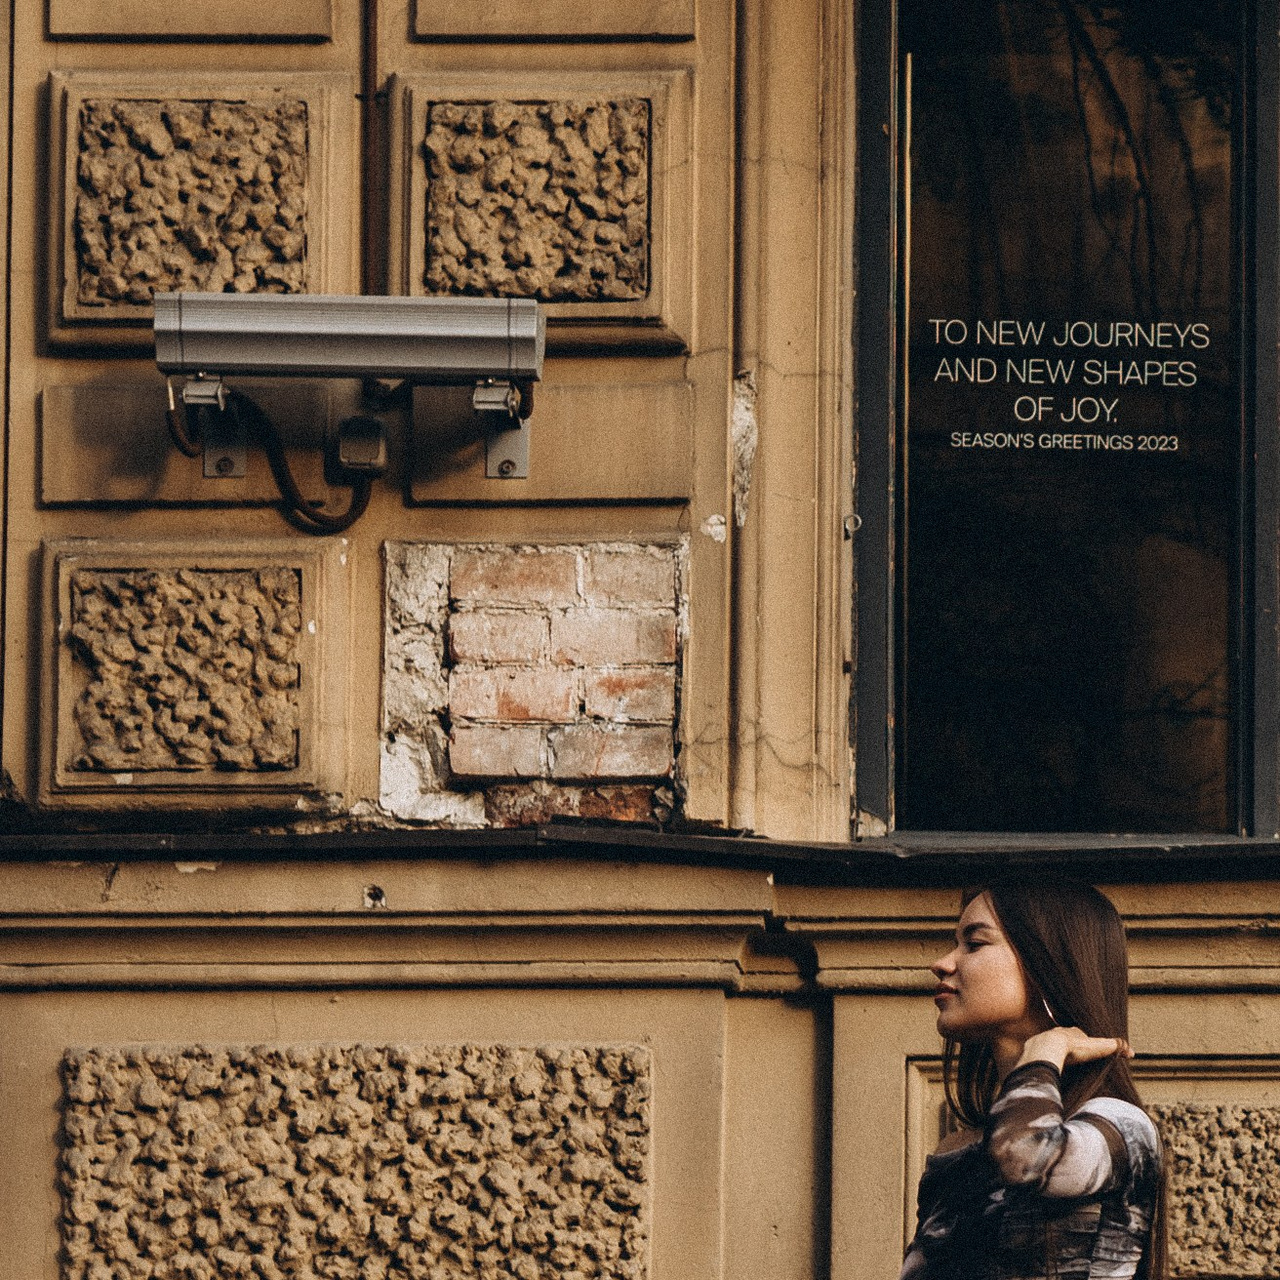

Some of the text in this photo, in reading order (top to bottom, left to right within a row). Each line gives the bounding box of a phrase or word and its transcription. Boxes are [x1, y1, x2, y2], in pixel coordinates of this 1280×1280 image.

[929, 319, 1210, 349] TO NEW JOURNEYS
[933, 357, 1198, 387] AND NEW SHAPES
[1013, 396, 1119, 423] OF JOY.
[950, 432, 1179, 452] SEASON'S GREETINGS 2023
